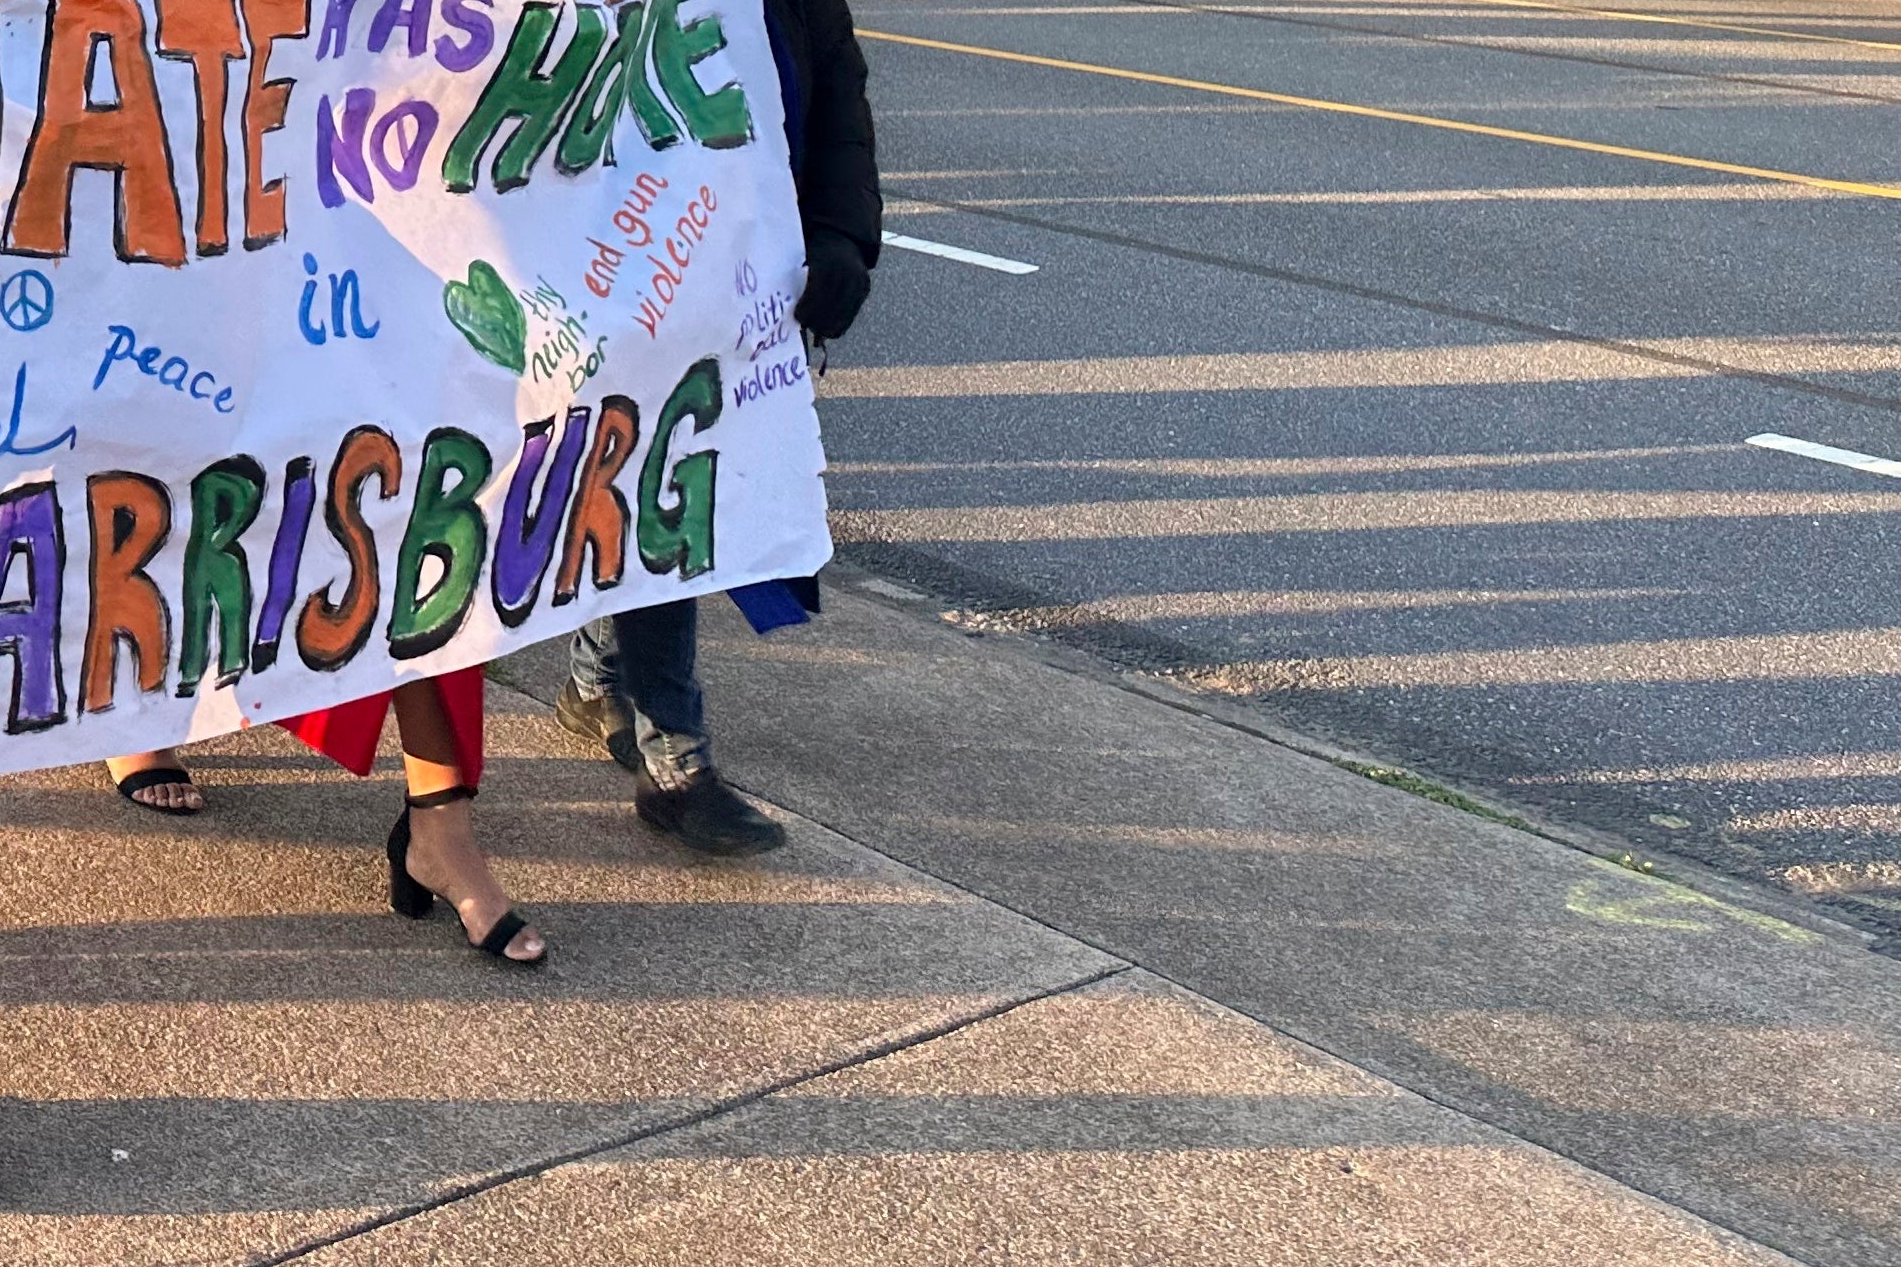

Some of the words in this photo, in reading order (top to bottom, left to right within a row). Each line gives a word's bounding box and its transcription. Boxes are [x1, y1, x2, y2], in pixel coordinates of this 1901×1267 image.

[316, 87, 440, 209] NO
[584, 235, 627, 300] end
[612, 171, 670, 249] gun
[630, 184, 719, 340] violence
[298, 251, 380, 347] in
[519, 274, 568, 323] thy
[565, 334, 609, 395] bor
[733, 354, 807, 409] violence
